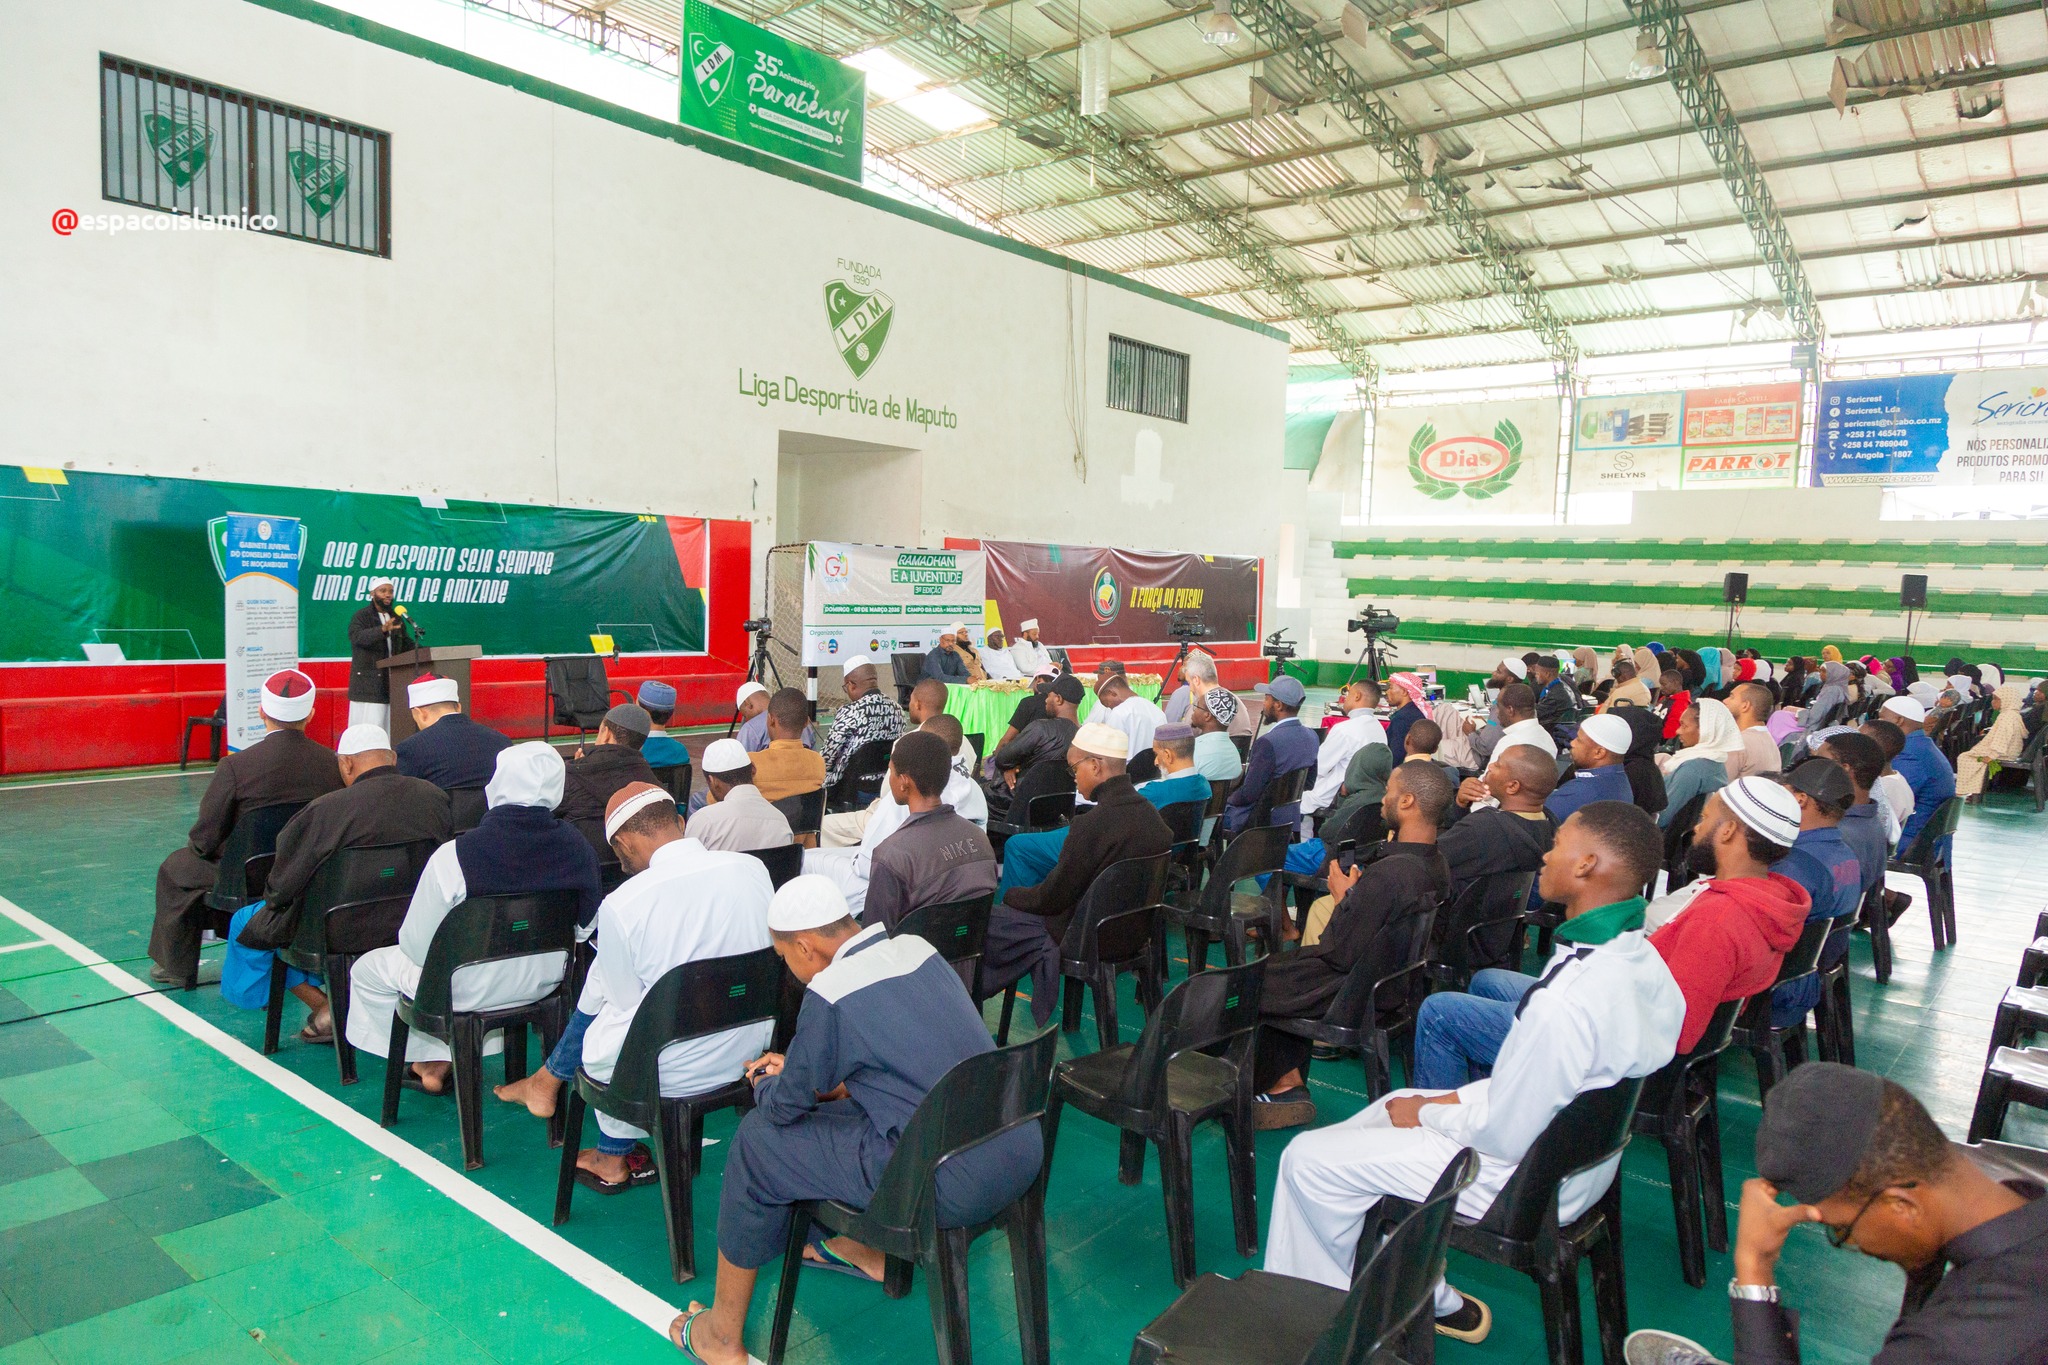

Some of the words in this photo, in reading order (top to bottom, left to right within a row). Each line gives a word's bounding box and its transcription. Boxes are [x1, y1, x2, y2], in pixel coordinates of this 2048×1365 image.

[702, 51, 724, 75] LDM
[778, 71, 816, 90] Aniversário
[747, 72, 850, 132] Parabéns!
[837, 257, 882, 280] FUNDADA
[853, 275, 871, 287] 1990
[840, 296, 884, 344] LDM
[739, 367, 780, 407] Liga
[784, 375, 878, 416] Desportiva
[882, 394, 901, 420] de
[906, 397, 958, 433] Maputo
[1846, 395, 1882, 404] Sericrest
[1845, 408, 1884, 416] Sericrest,
[1885, 406, 1901, 414] Lda
[1845, 431, 1865, 439] +258
[1866, 430, 1876, 438] 21
[1877, 429, 1907, 438] 465479
[1842, 441, 1862, 449] +258
[1439, 449, 1493, 468] Dias
[1841, 451, 1854, 460] Av.
[1855, 450, 1884, 461] Angola
[1956, 455, 2010, 467] PRODUTOS
[1687, 453, 1791, 472] PARROT
[1600, 472, 1646, 480] SHELYNS
[1823, 473, 1935, 485] WWW.SERICREST.COM
[1999, 471, 2027, 483] PARA
[2029, 470, 2044, 483] SI!
[230, 550, 240, 558] DO
[241, 551, 272, 559] CONSELHO
[322, 541, 358, 568] QUE
[359, 542, 374, 569] O
[375, 543, 457, 572] DESPORTO
[457, 547, 495, 573] SEJA
[495, 549, 555, 575] SEMPRE
[898, 554, 955, 567] RAMADHAN
[892, 570, 899, 582] E
[900, 570, 908, 582] A
[910, 571, 962, 583] JUVENTUDE
[312, 574, 353, 601] UMA
[418, 577, 442, 603] DE
[442, 578, 510, 604] AMIZADE
[1130, 587, 1137, 608] A
[1137, 587, 1163, 613] FORÇA
[1174, 588, 1204, 609] FUTSAL!
[865, 704, 895, 716] IVALDO
[940, 838, 979, 861] NIKE
